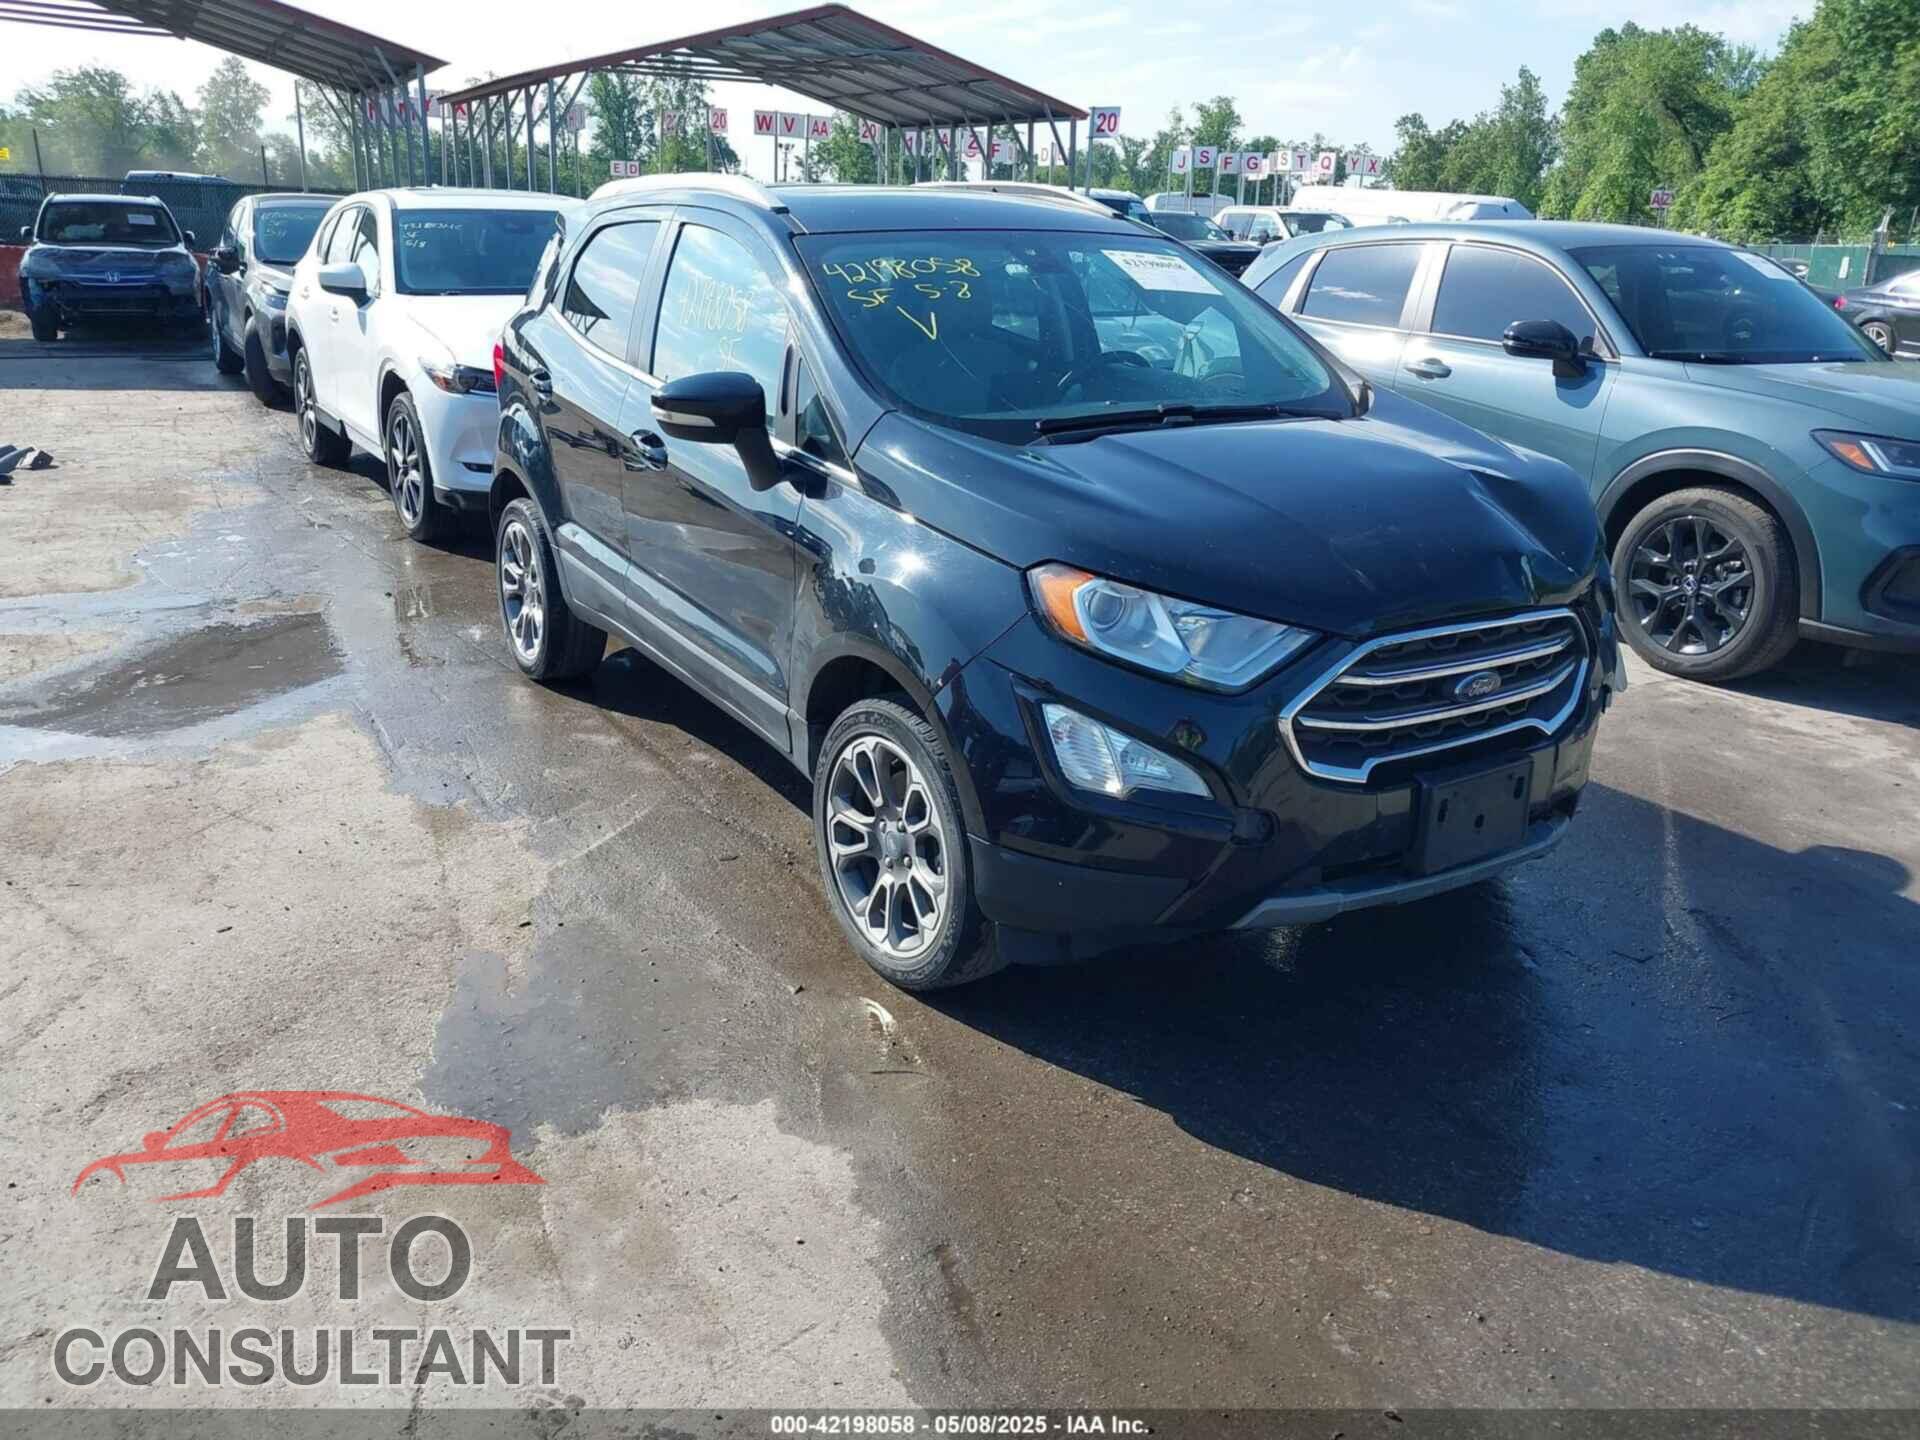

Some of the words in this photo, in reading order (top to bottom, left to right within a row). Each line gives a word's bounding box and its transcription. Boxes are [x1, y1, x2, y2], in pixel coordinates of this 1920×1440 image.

[712, 112, 727, 129] 20
[756, 114, 772, 131] W
[784, 117, 794, 132] V
[811, 119, 829, 136] AA
[1096, 112, 1118, 132] 20
[1178, 155, 1186, 168] J
[1200, 150, 1210, 164] S
[1223, 156, 1233, 170] F
[1246, 156, 1258, 170] G
[1280, 152, 1288, 166] S
[1296, 155, 1305, 168] T
[1320, 155, 1332, 170] Q
[1351, 157, 1359, 171] Y
[613, 162, 622, 174] E
[630, 163, 638, 175] D
[1368, 159, 1377, 173] X
[822, 257, 981, 284] 42198058
